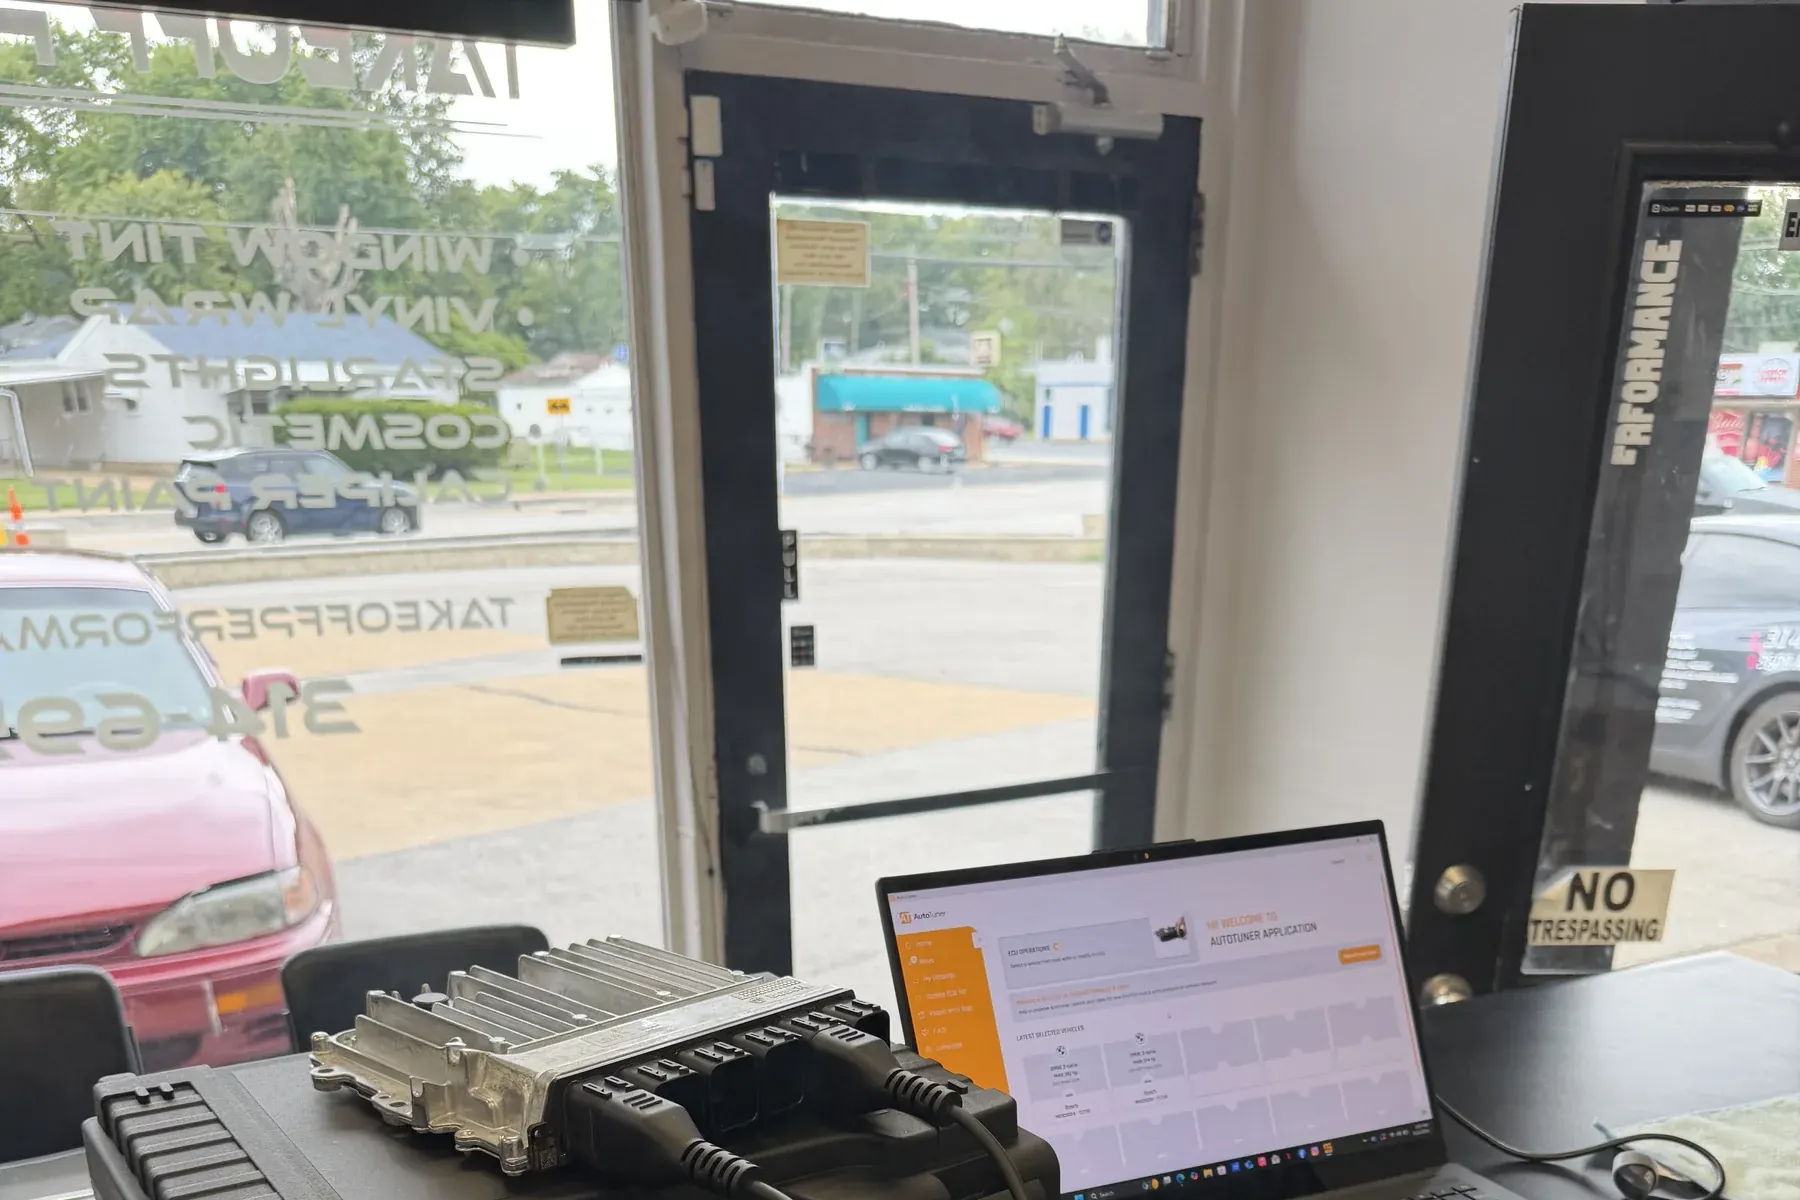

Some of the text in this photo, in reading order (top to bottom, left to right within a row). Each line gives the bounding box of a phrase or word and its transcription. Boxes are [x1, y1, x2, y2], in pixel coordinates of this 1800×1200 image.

[1566, 872, 1636, 912] NO
[1222, 913, 1263, 928] WELCOME
[1266, 912, 1277, 921] TO
[1529, 918, 1661, 943] TRESPASSING
[1210, 922, 1317, 946] AUTOTUNER APPLICATION
[1016, 1025, 1084, 1042] LATEST SELECTED VEHICLES
